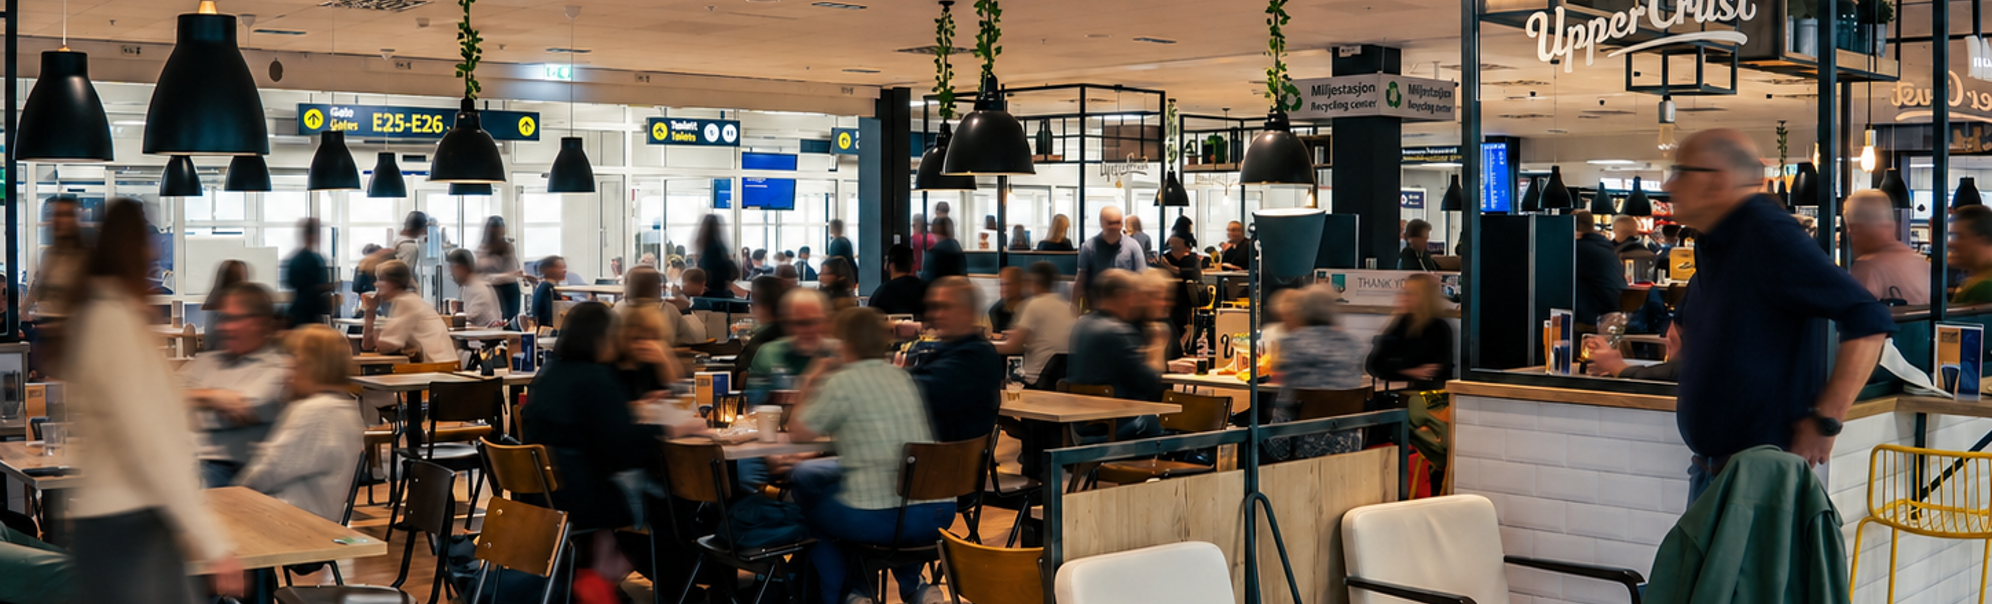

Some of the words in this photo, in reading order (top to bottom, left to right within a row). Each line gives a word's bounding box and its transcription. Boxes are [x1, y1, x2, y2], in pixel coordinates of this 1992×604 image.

[1525, 5, 1646, 73] Upper
[1310, 82, 1376, 98] Miljestasjon
[1310, 100, 1349, 112] Recycling
[372, 112, 444, 134] E25-E26
[1357, 276, 1392, 289] THANK
[1394, 277, 1407, 290] YO
